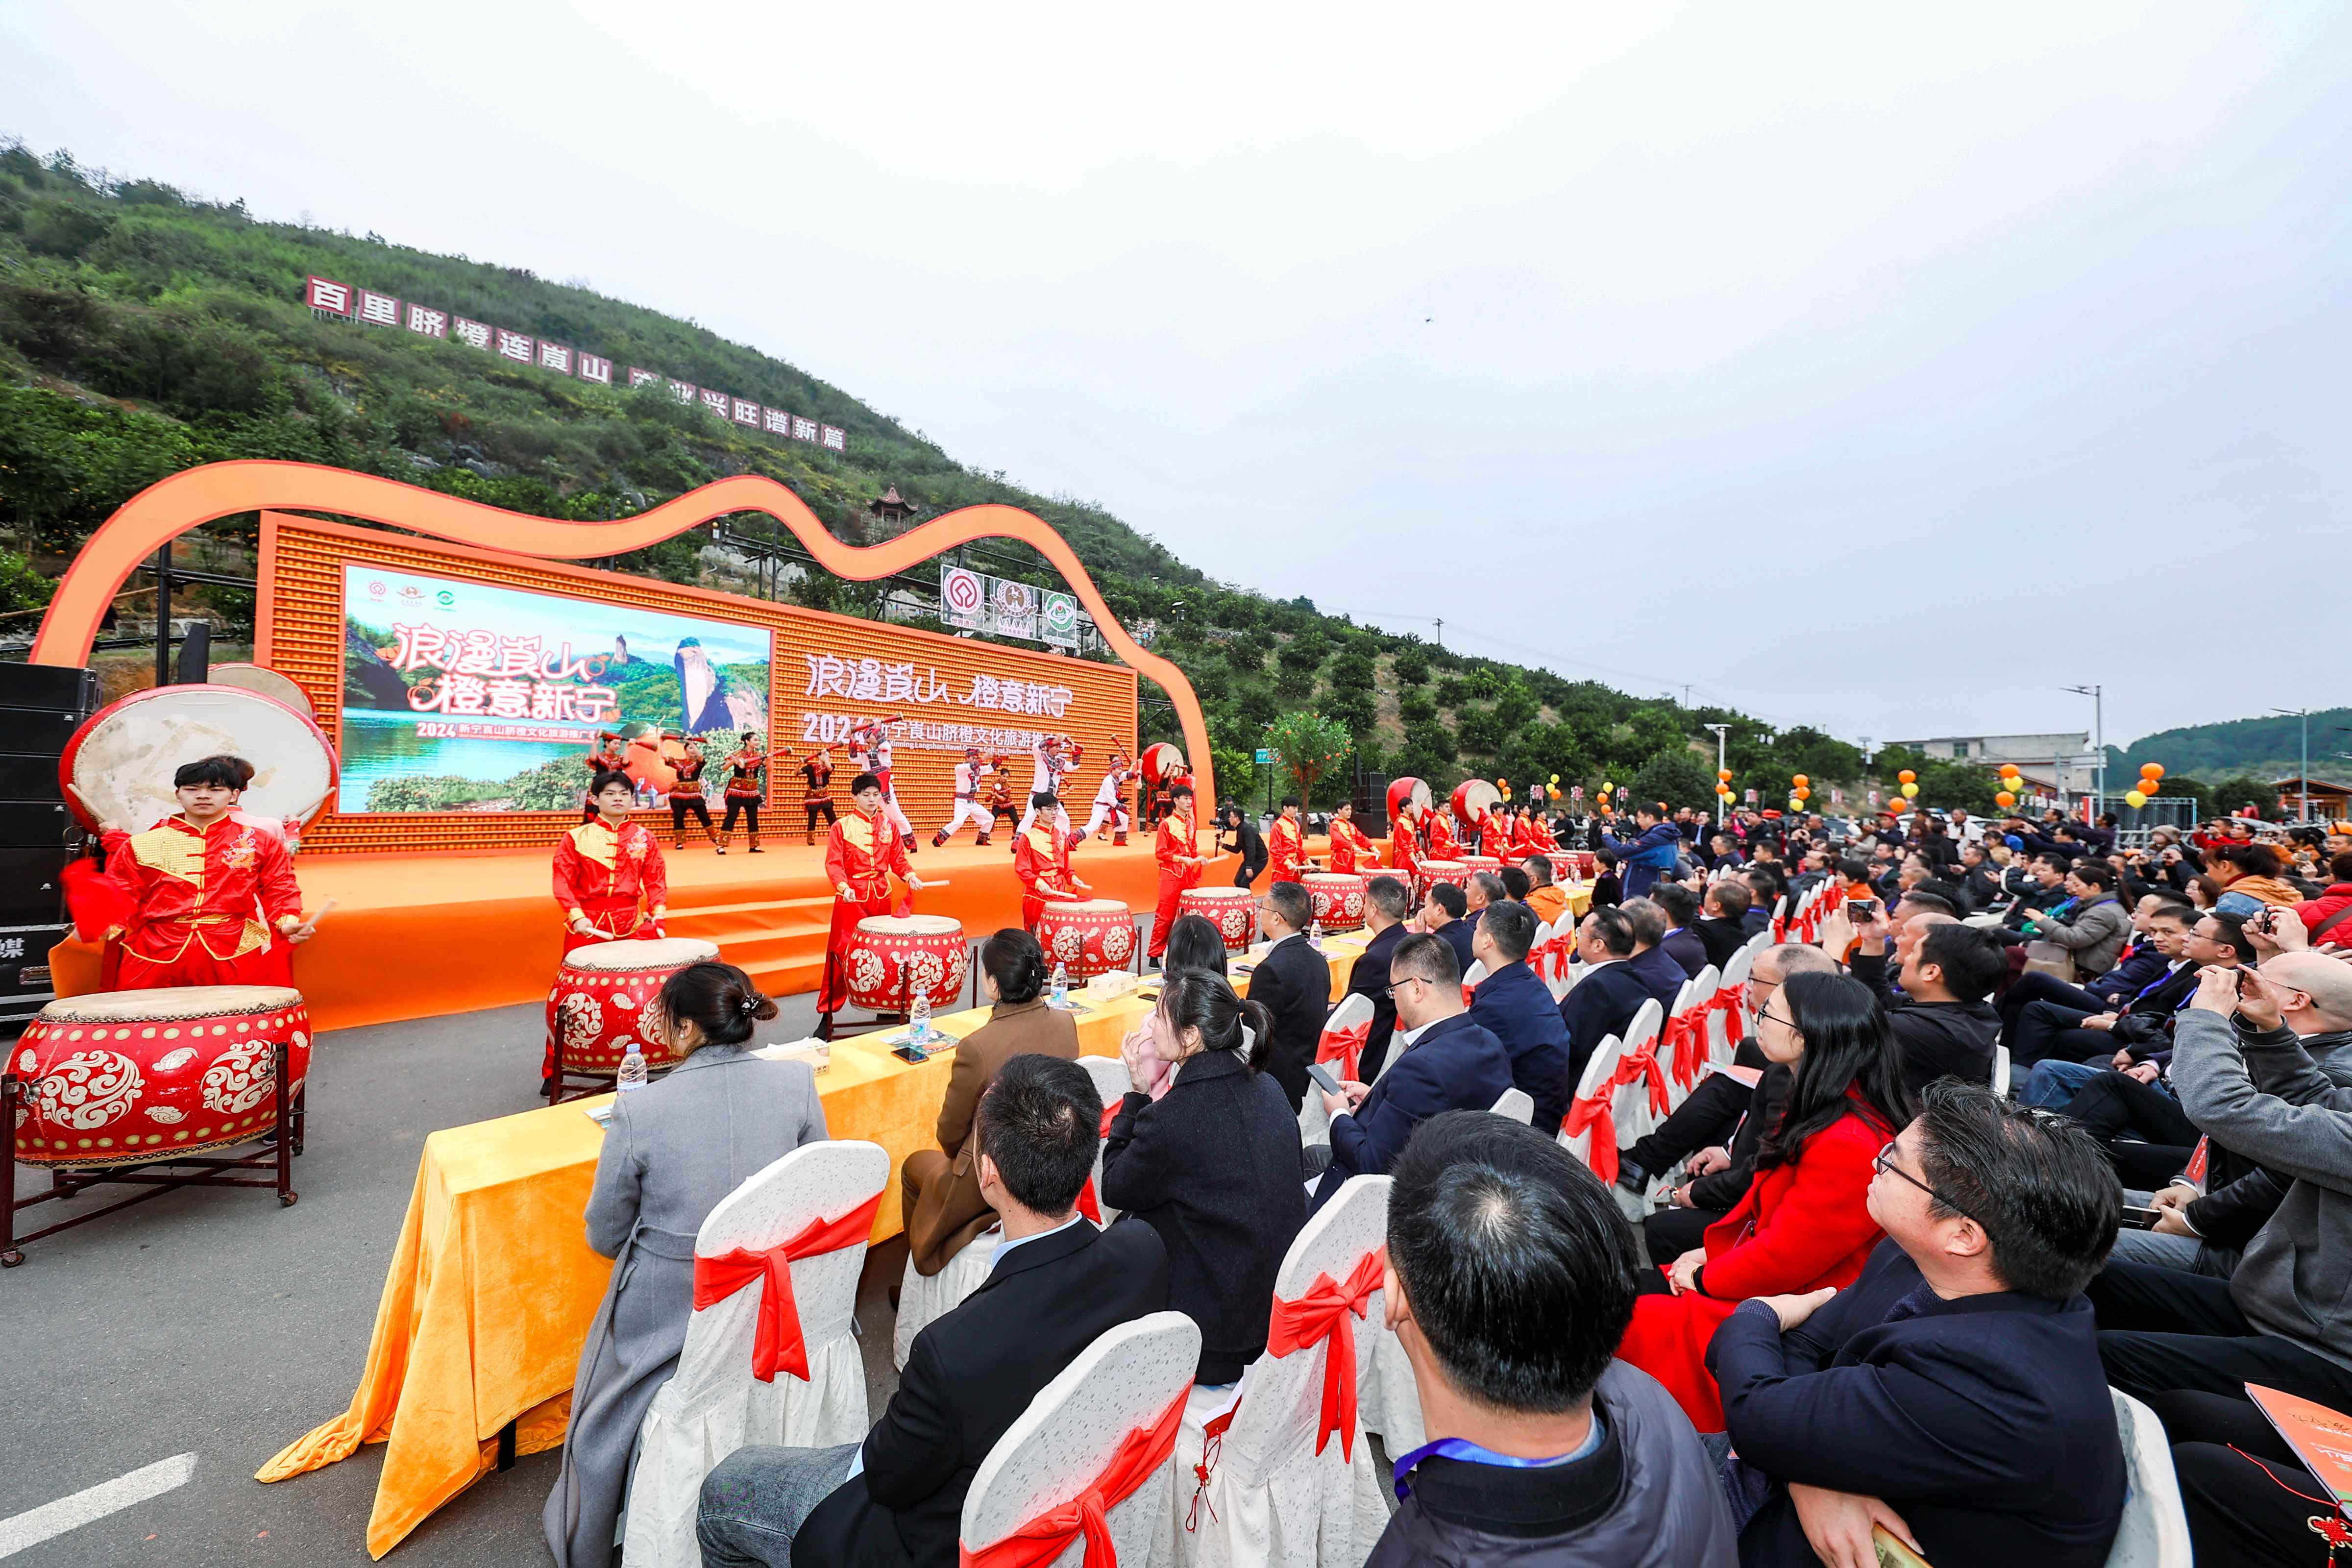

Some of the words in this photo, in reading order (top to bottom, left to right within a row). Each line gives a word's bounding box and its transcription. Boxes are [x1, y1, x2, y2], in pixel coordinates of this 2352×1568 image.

[411, 672, 617, 723] 橙意新宁
[958, 674, 1074, 718] 橙意新宁
[416, 722, 456, 738] 2024
[890, 740, 914, 749] Xinning
[915, 742, 944, 750] Langshan
